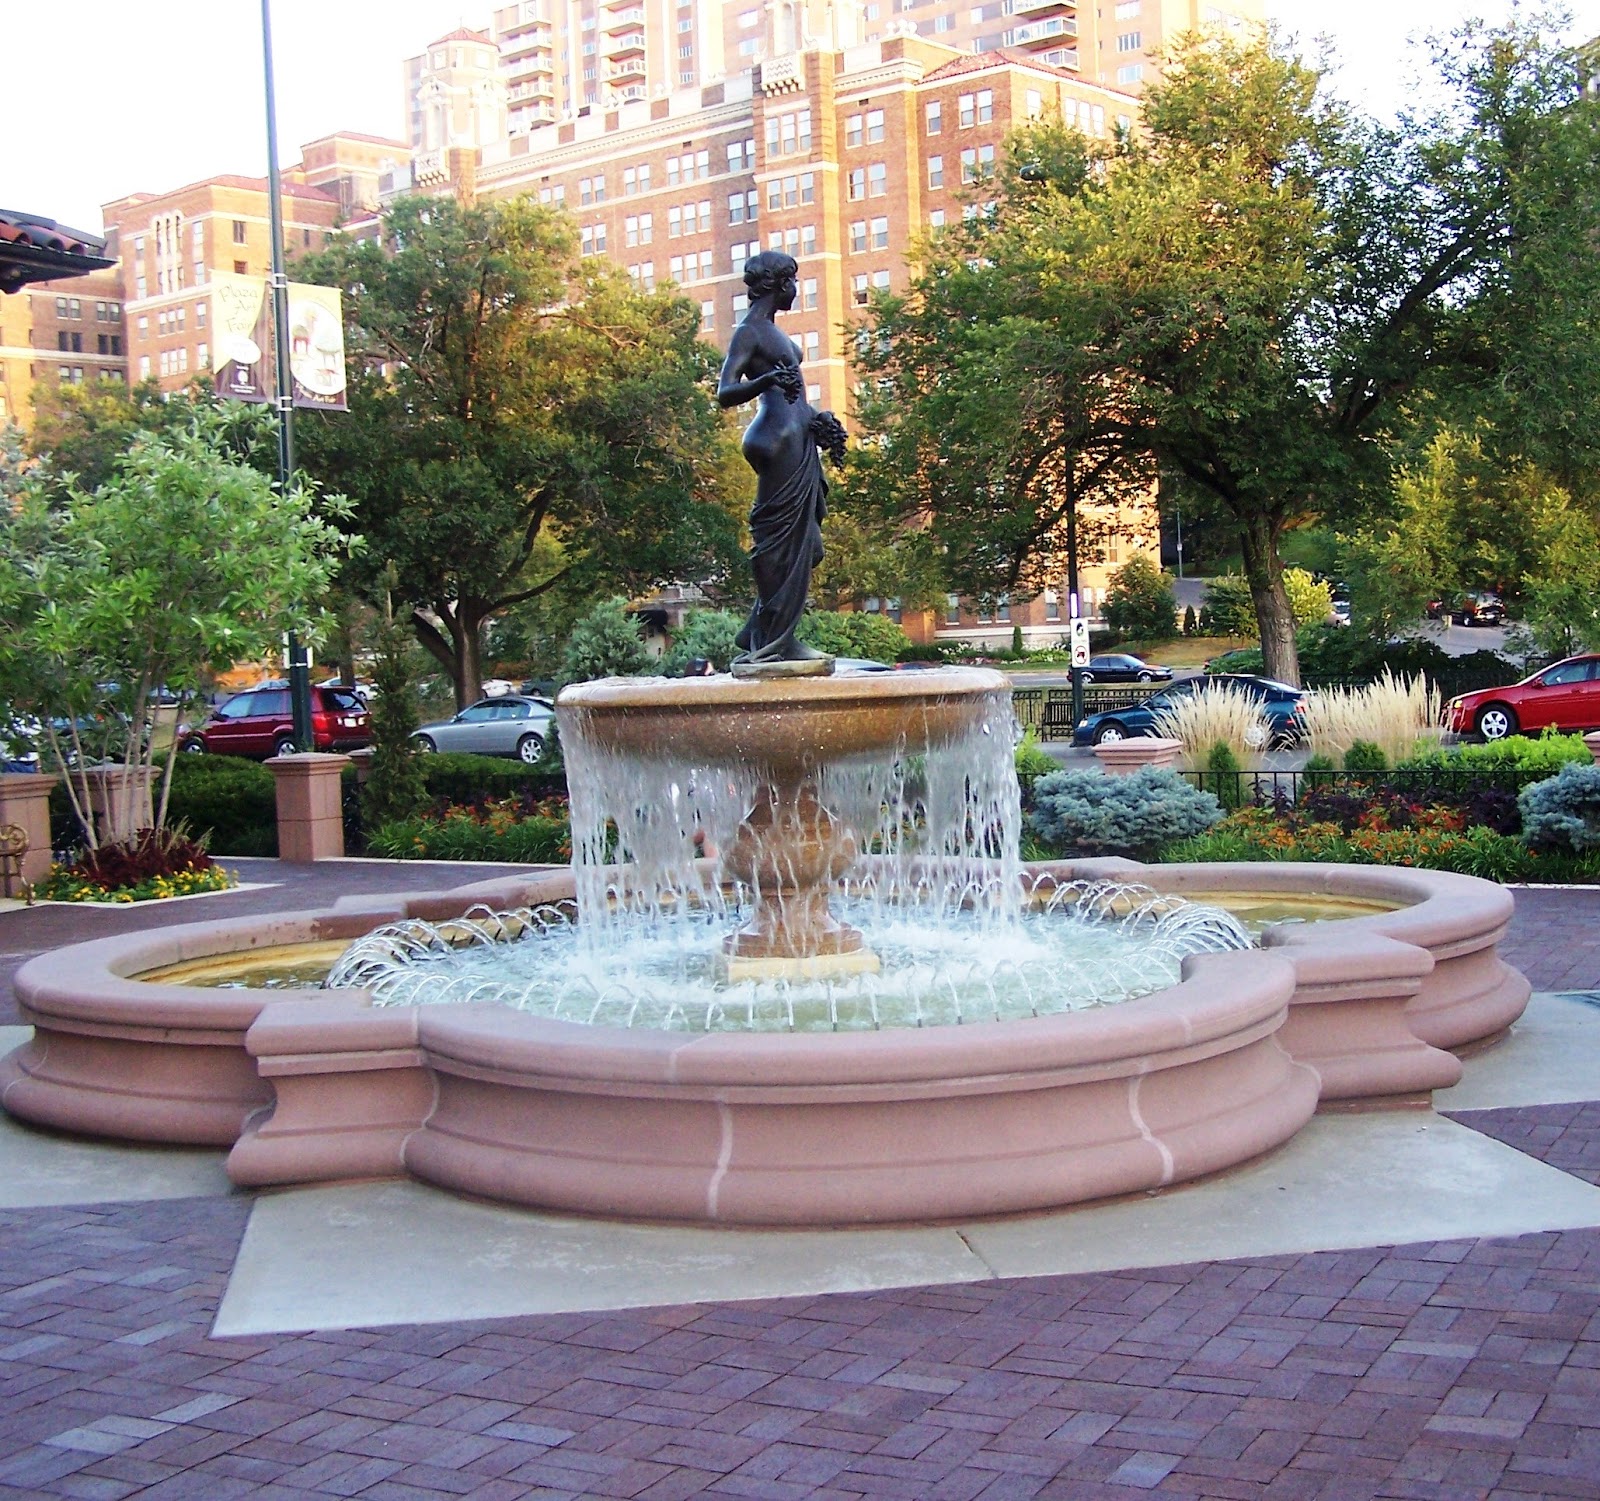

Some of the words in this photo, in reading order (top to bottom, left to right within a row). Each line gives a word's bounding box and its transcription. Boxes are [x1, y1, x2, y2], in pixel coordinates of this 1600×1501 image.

[219, 284, 258, 302] Plaza
[234, 299, 257, 316] Art
[226, 317, 252, 332] Fair
